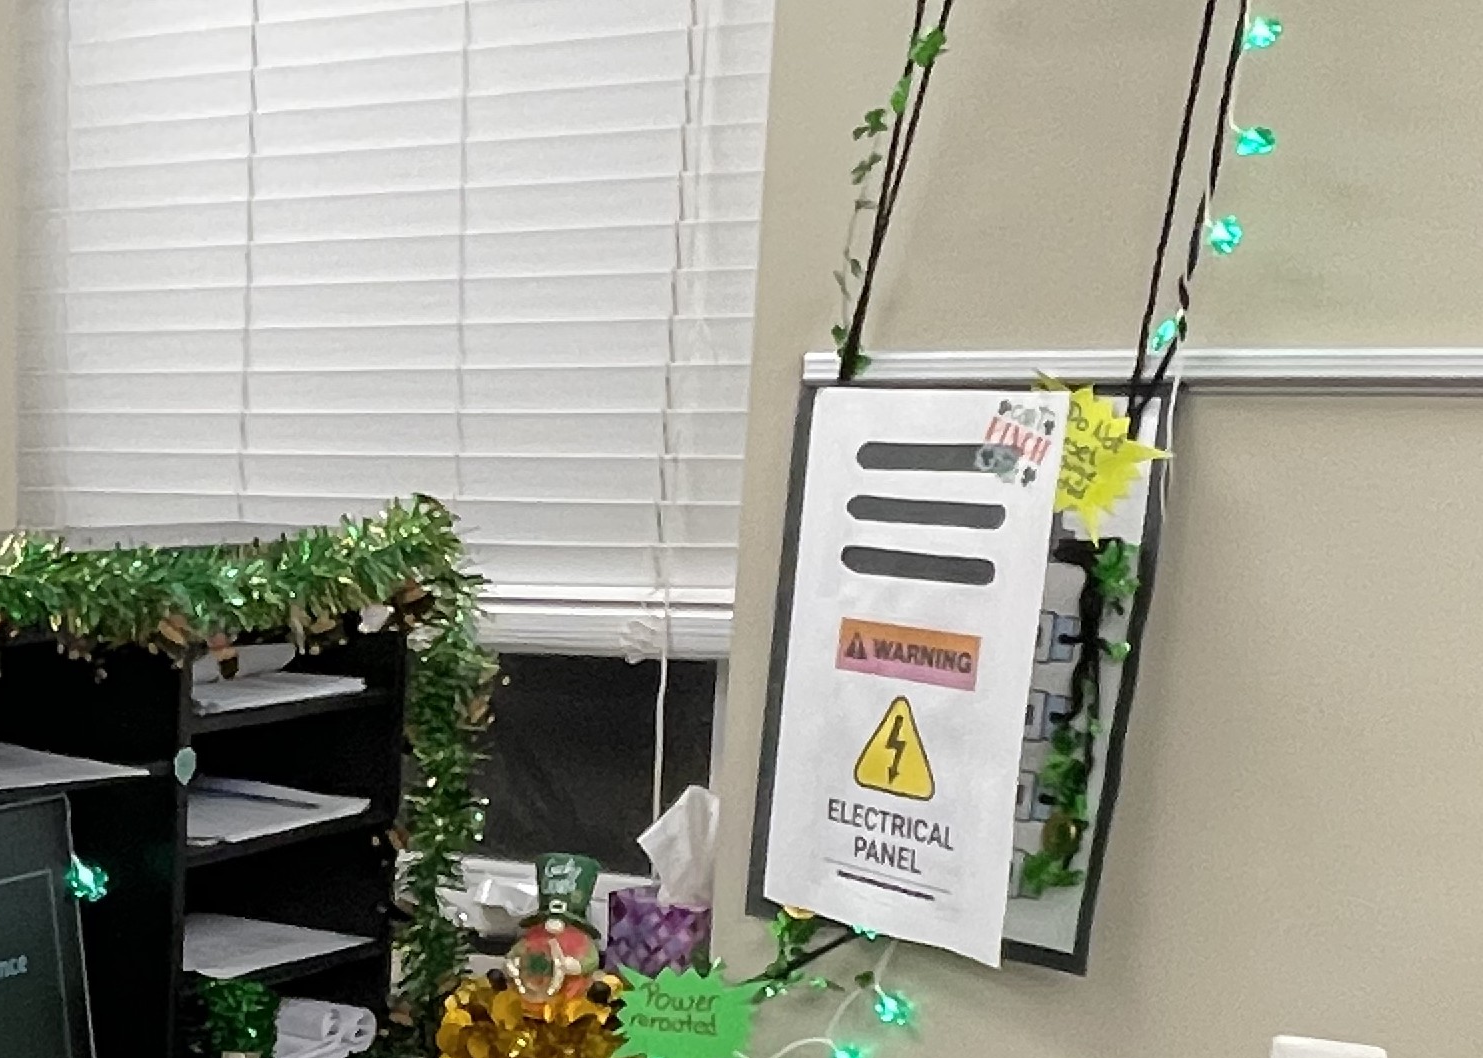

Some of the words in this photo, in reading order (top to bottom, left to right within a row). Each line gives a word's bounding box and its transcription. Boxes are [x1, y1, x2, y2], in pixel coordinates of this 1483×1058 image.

[870, 637, 972, 674] WARNING
[826, 797, 955, 852] ELECTRICAL
[852, 836, 922, 876] PANEL
[639, 983, 717, 1012] Power
